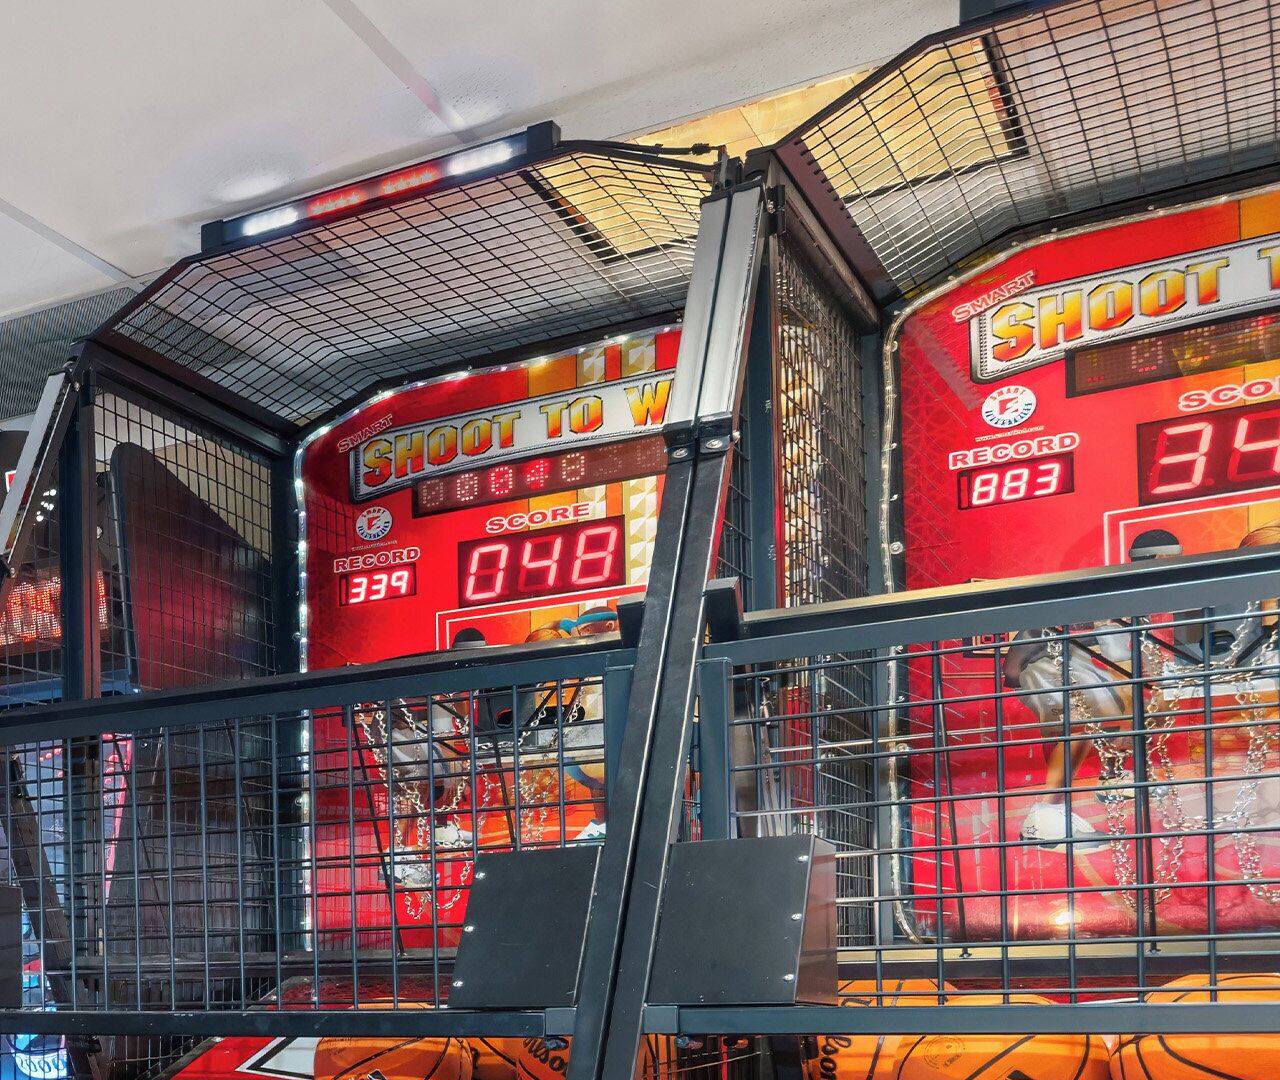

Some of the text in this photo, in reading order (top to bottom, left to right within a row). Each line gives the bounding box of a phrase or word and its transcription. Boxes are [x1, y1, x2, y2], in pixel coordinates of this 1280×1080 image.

[951, 270, 1034, 323] SMART
[991, 257, 1230, 364] SHOOT
[1178, 375, 1280, 412] SCO
[337, 414, 393, 453] SMART
[362, 411, 521, 487] SHOOT
[539, 395, 603, 439] TO
[948, 432, 1080, 470] RECORD
[1151, 414, 1280, 497] 34
[971, 462, 1061, 505] 883
[485, 502, 591, 534] SCORE
[333, 546, 420, 573] RECORD
[464, 525, 618, 602] 048
[349, 570, 409, 603] 339
